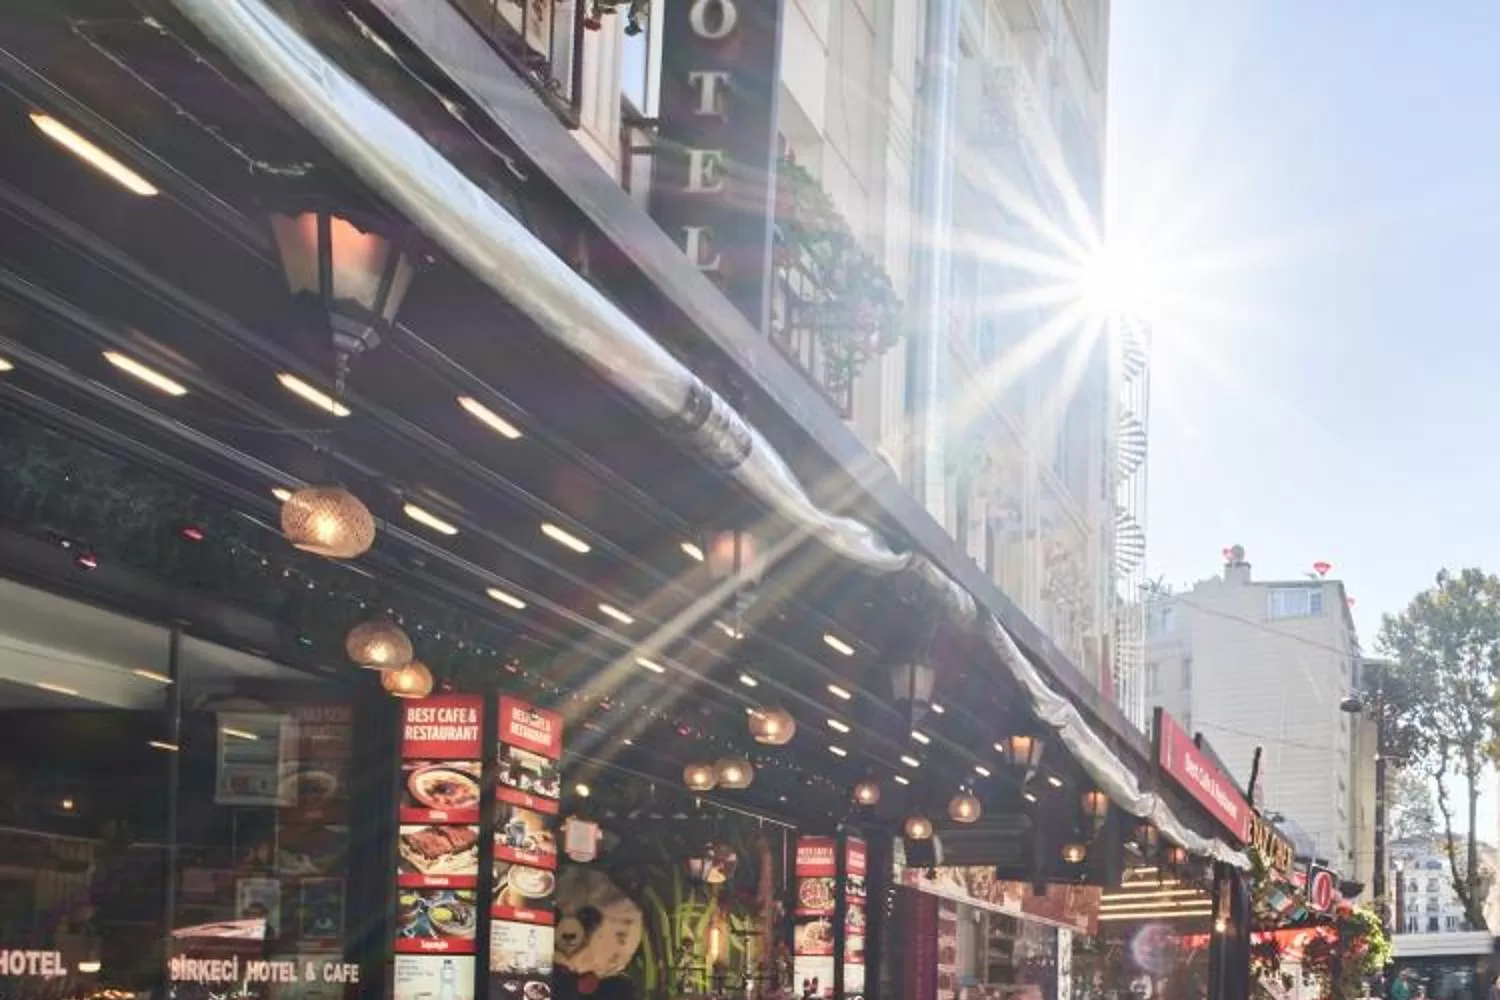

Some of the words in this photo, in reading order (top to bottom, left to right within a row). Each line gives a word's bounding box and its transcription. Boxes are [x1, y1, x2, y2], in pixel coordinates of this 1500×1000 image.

[407, 708, 437, 723] BEST
[437, 708, 466, 723] CAFE
[405, 725, 479, 741] RESTAURANT
[246, 960, 298, 982] HOTEL
[305, 960, 316, 982] &
[323, 962, 360, 983] CAFE
